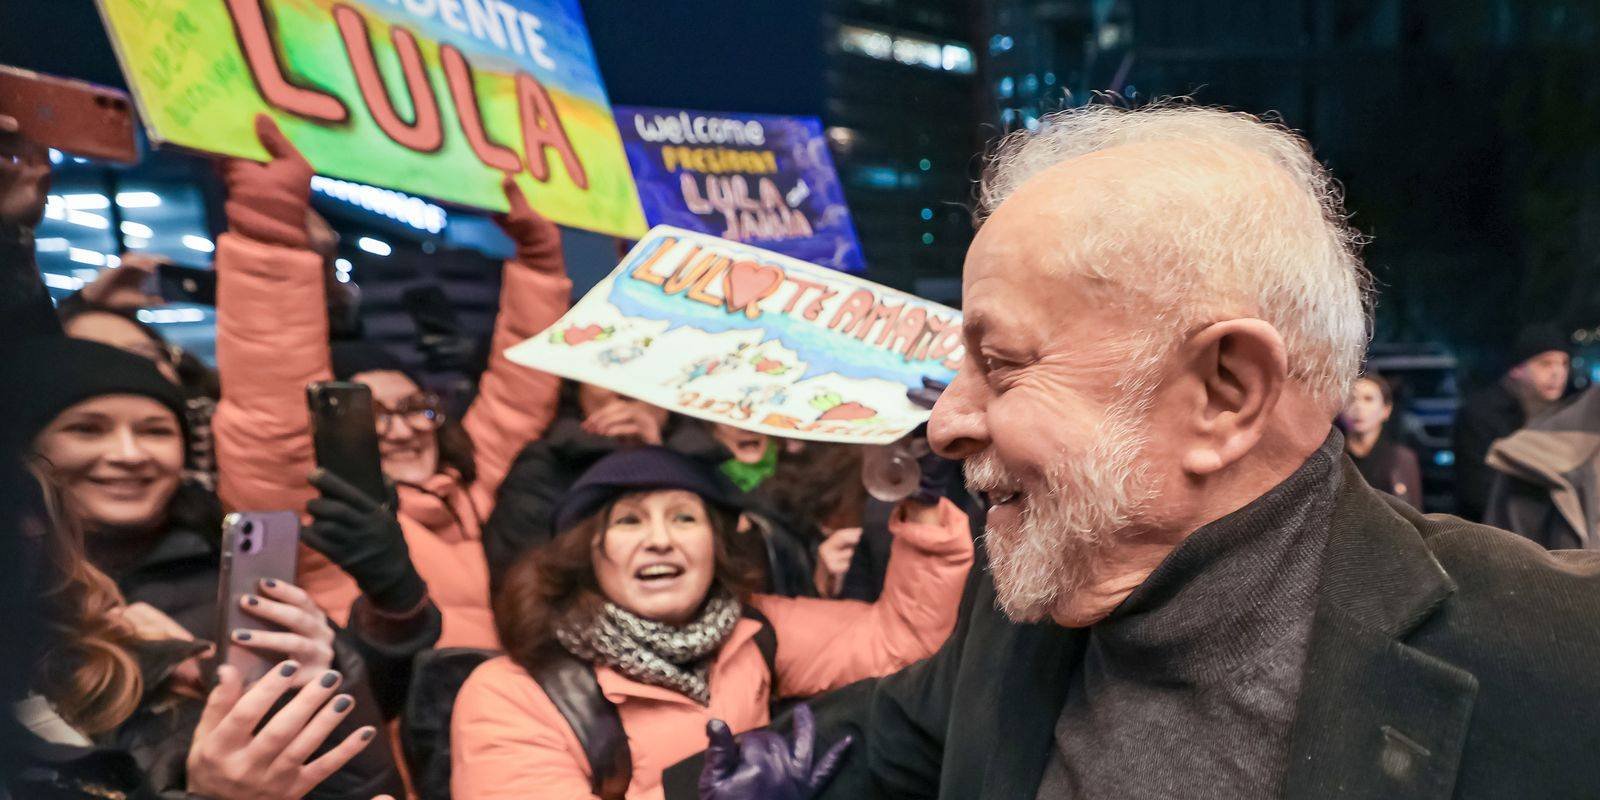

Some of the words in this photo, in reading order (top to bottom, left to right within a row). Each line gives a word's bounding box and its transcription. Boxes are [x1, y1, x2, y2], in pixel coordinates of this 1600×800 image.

[226, 0, 588, 189] LULA
[680, 173, 790, 222] LULA
[828, 289, 963, 371] AMAMO
